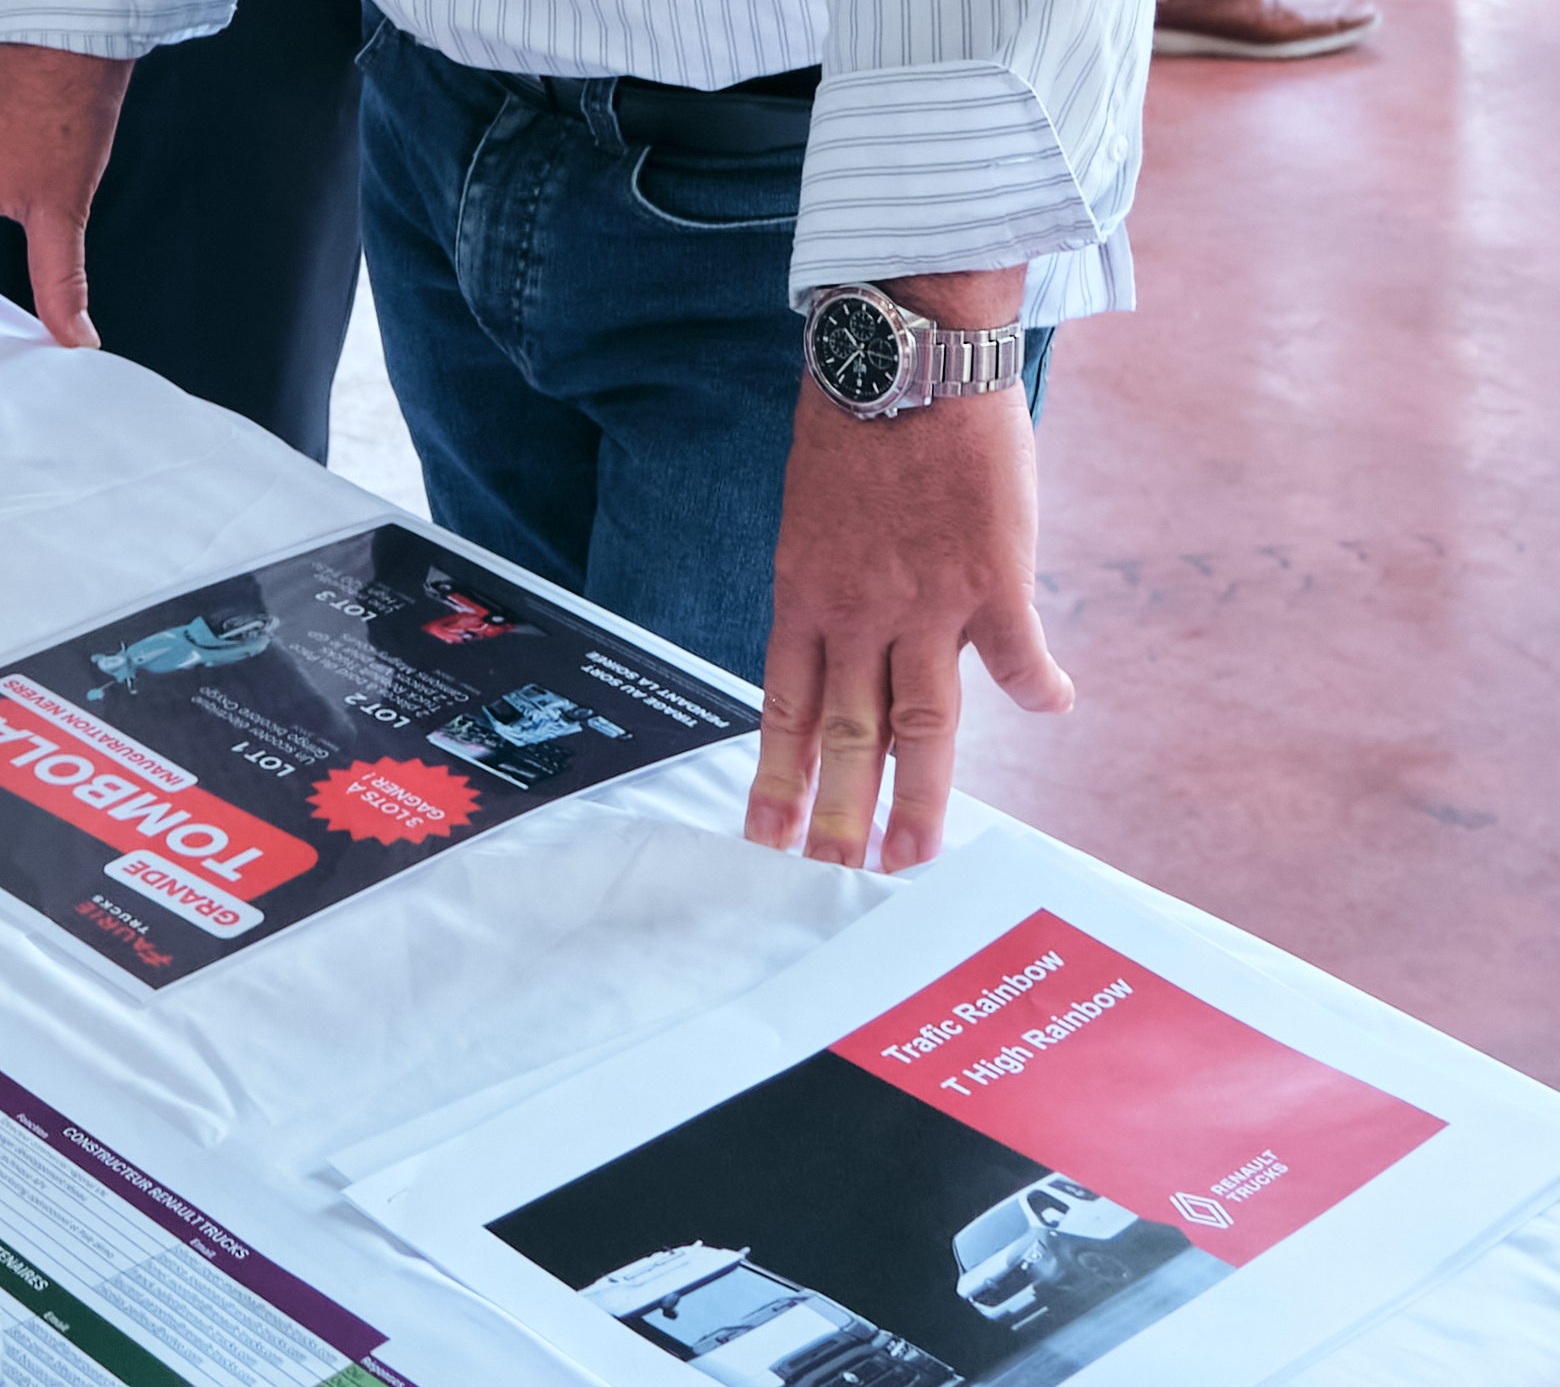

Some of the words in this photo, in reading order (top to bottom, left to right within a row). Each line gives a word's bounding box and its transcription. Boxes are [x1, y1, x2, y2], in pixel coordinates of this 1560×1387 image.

[310, 588, 340, 602] 3
[327, 596, 379, 621] LOT
[577, 662, 625, 687] SORT
[632, 676, 662, 691] LA
[0, 678, 69, 716] NEVERS
[339, 691, 369, 706] 2
[617, 682, 649, 699] AU
[356, 700, 413, 728] LOT
[640, 695, 701, 727] TIRAGE
[653, 687, 732, 729] PENDANT
[59, 712, 186, 785] INAUGURATION
[227, 740, 255, 753] 1
[241, 747, 298, 777] LOT
[338, 780, 367, 795] À
[365, 775, 450, 821] GAGNER
[356, 789, 412, 820] LOTS
[401, 815, 426, 828] 3
[120, 859, 246, 928] GRANDE
[86, 893, 154, 934] TRUCKS
[878, 1014, 968, 1068] Trafic
[948, 949, 1072, 1025] Rainbow
[937, 1075, 978, 1100] T
[960, 1040, 1037, 1086] High
[1018, 977, 1140, 1051] Rainbow
[1208, 1148, 1282, 1197] RENAULT
[1224, 1160, 1291, 1205] TRUCKS
[58, 1125, 157, 1191] CONSTRUCTEUR
[144, 1185, 206, 1226] RENAULT
[194, 1220, 253, 1260] TRUCKS
